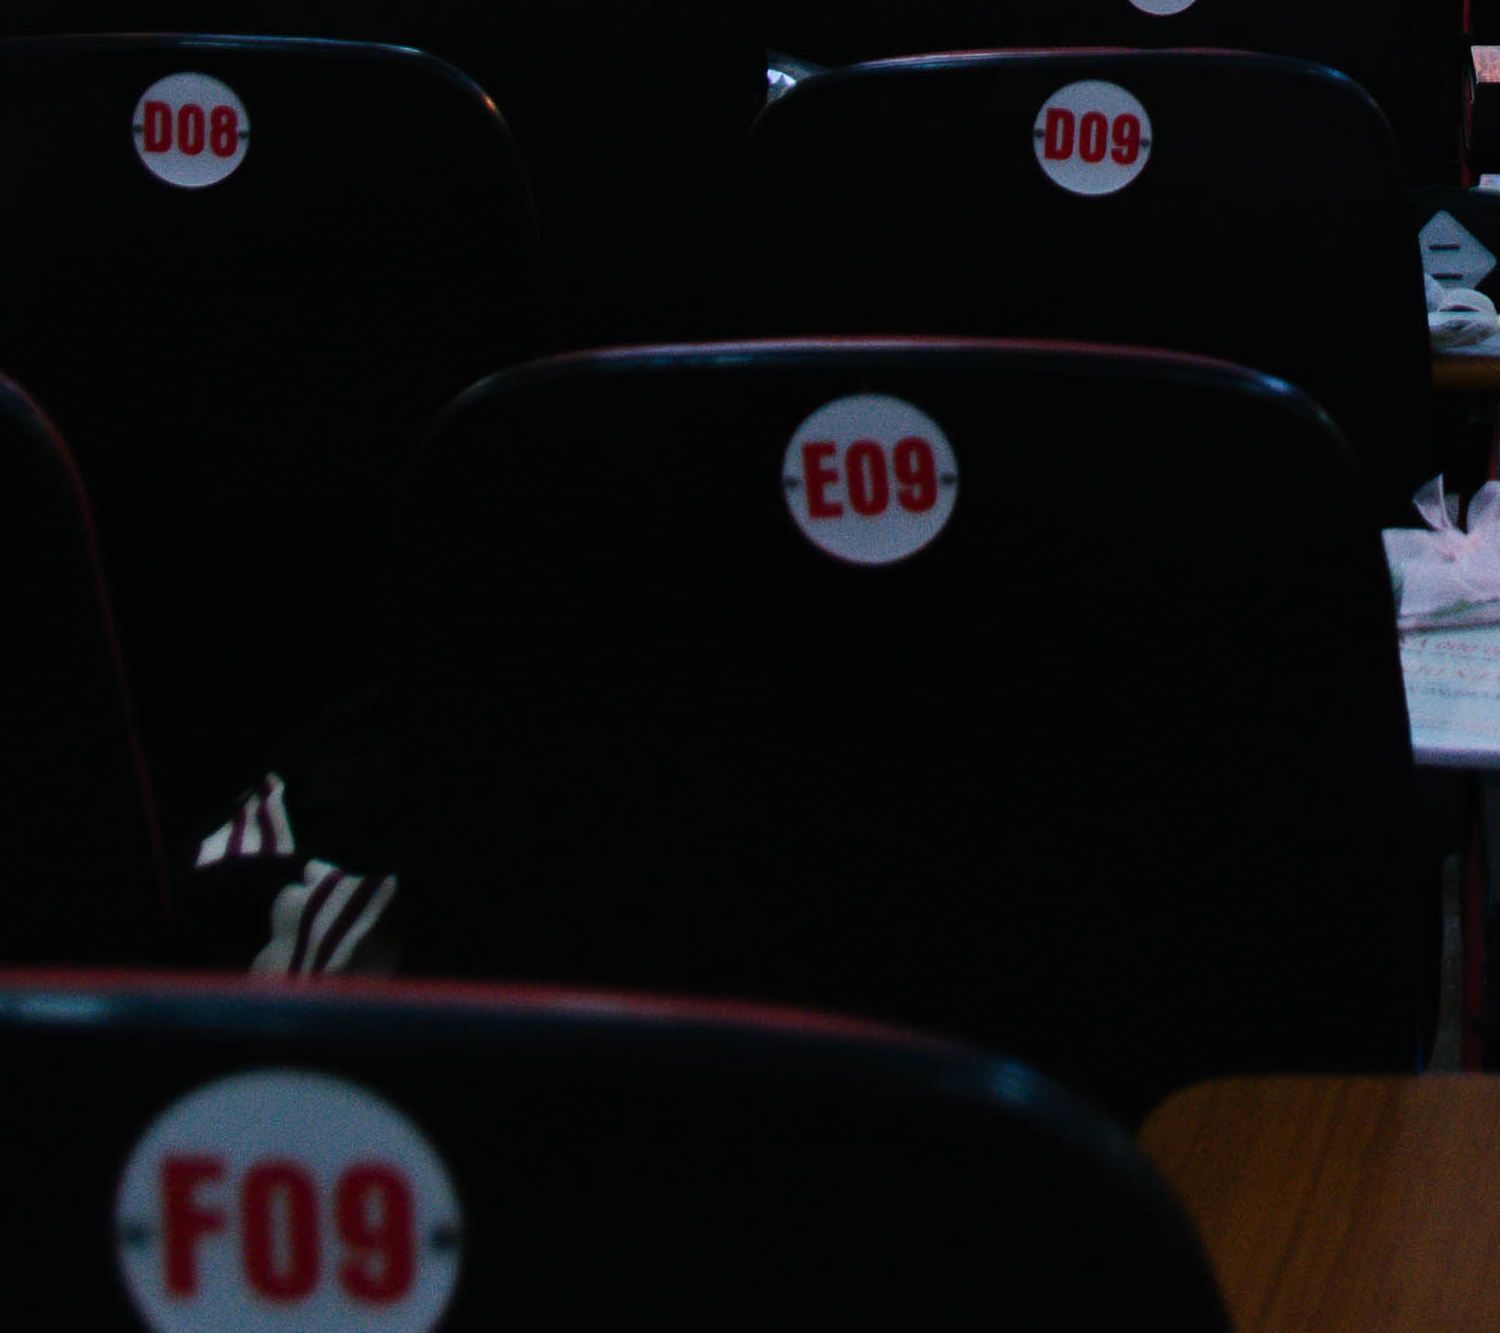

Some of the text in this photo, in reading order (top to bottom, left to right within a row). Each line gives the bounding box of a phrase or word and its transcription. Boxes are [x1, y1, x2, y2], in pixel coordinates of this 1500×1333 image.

[143, 101, 238, 158] D08
[1045, 108, 1140, 165] D09
[803, 438, 938, 519] E09
[162, 1156, 416, 1307] F09
